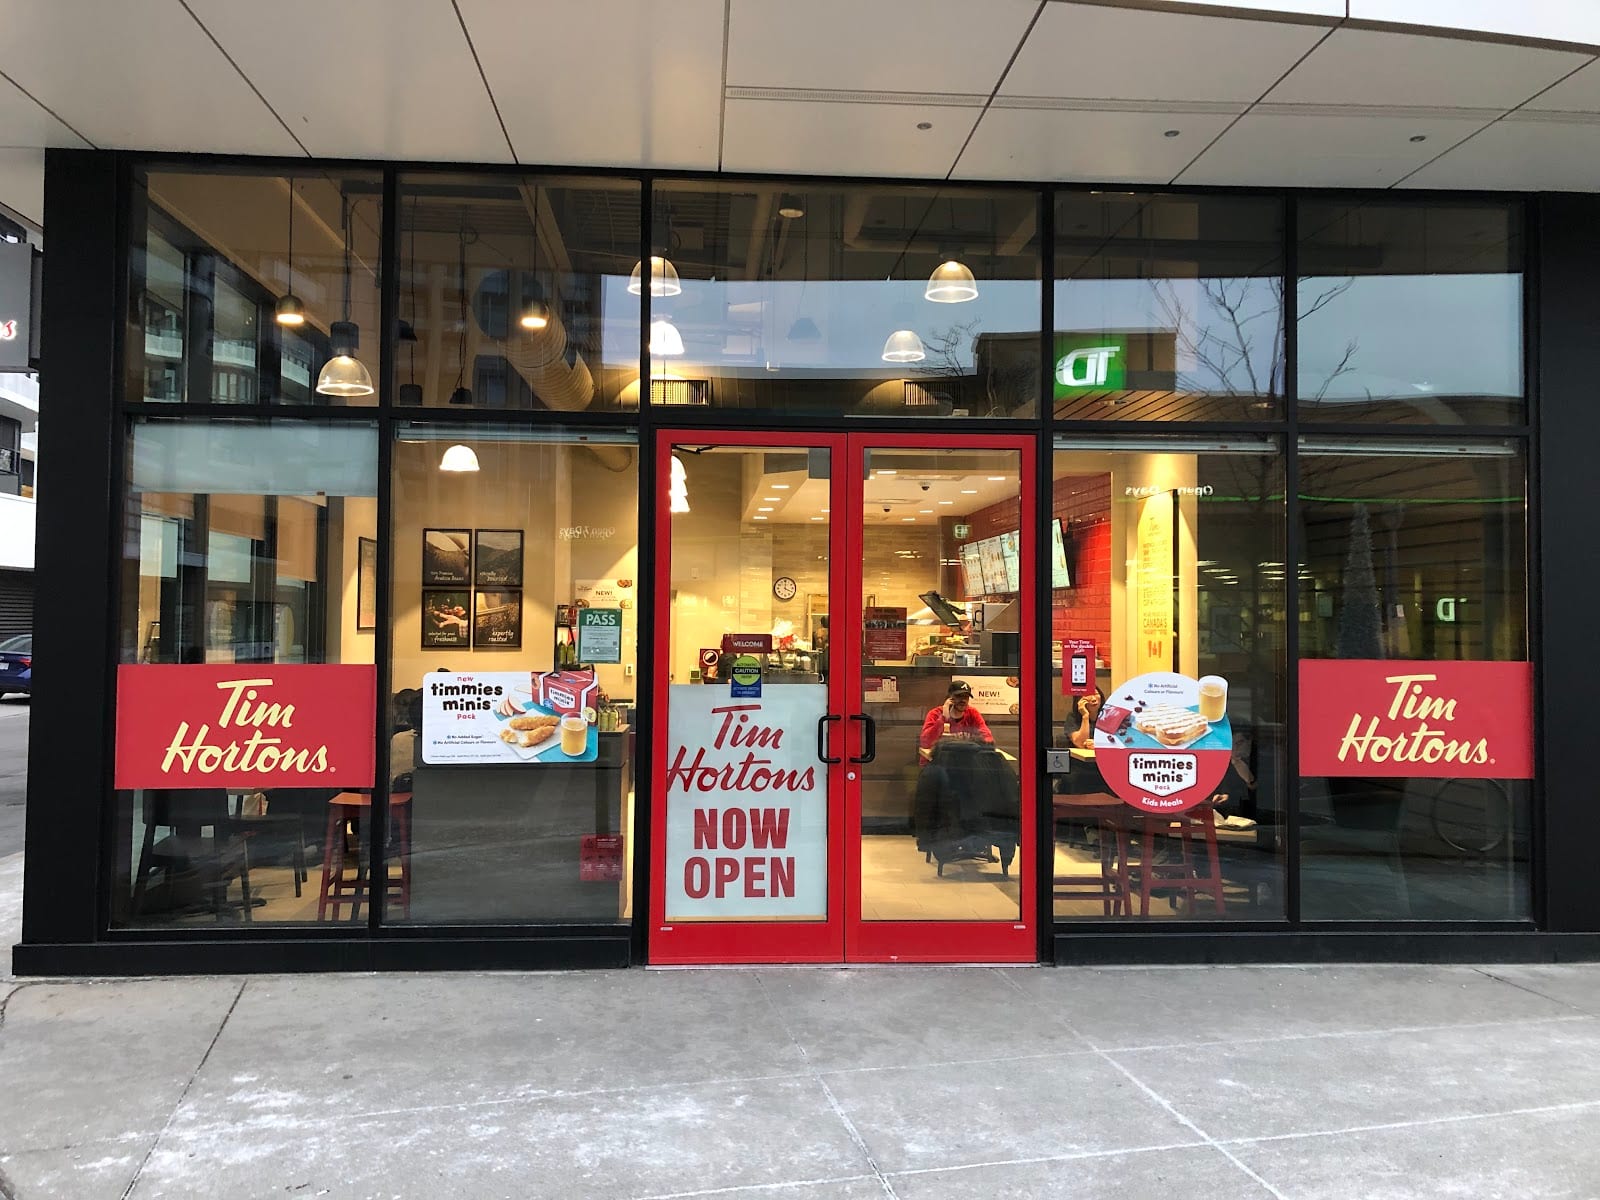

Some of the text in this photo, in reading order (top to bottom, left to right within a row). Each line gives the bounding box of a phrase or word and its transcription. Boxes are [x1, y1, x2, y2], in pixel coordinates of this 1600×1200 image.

[586, 614, 616, 626] PASS
[217, 678, 295, 728] Tim
[431, 682, 503, 696] timmies
[978, 690, 1001, 698] NEW!
[1385, 674, 1457, 721] Tim
[442, 697, 491, 711] minis
[711, 704, 784, 751] Tim
[1337, 713, 1488, 764] Hortons
[160, 721, 329, 774] Hortons
[667, 745, 815, 793] Hortons
[1132, 758, 1193, 770] timmies
[1142, 770, 1184, 783] minis
[1141, 796, 1158, 807] Kids
[1159, 798, 1183, 807] Meals
[693, 808, 791, 850] NOW
[683, 856, 796, 899] OPEN
